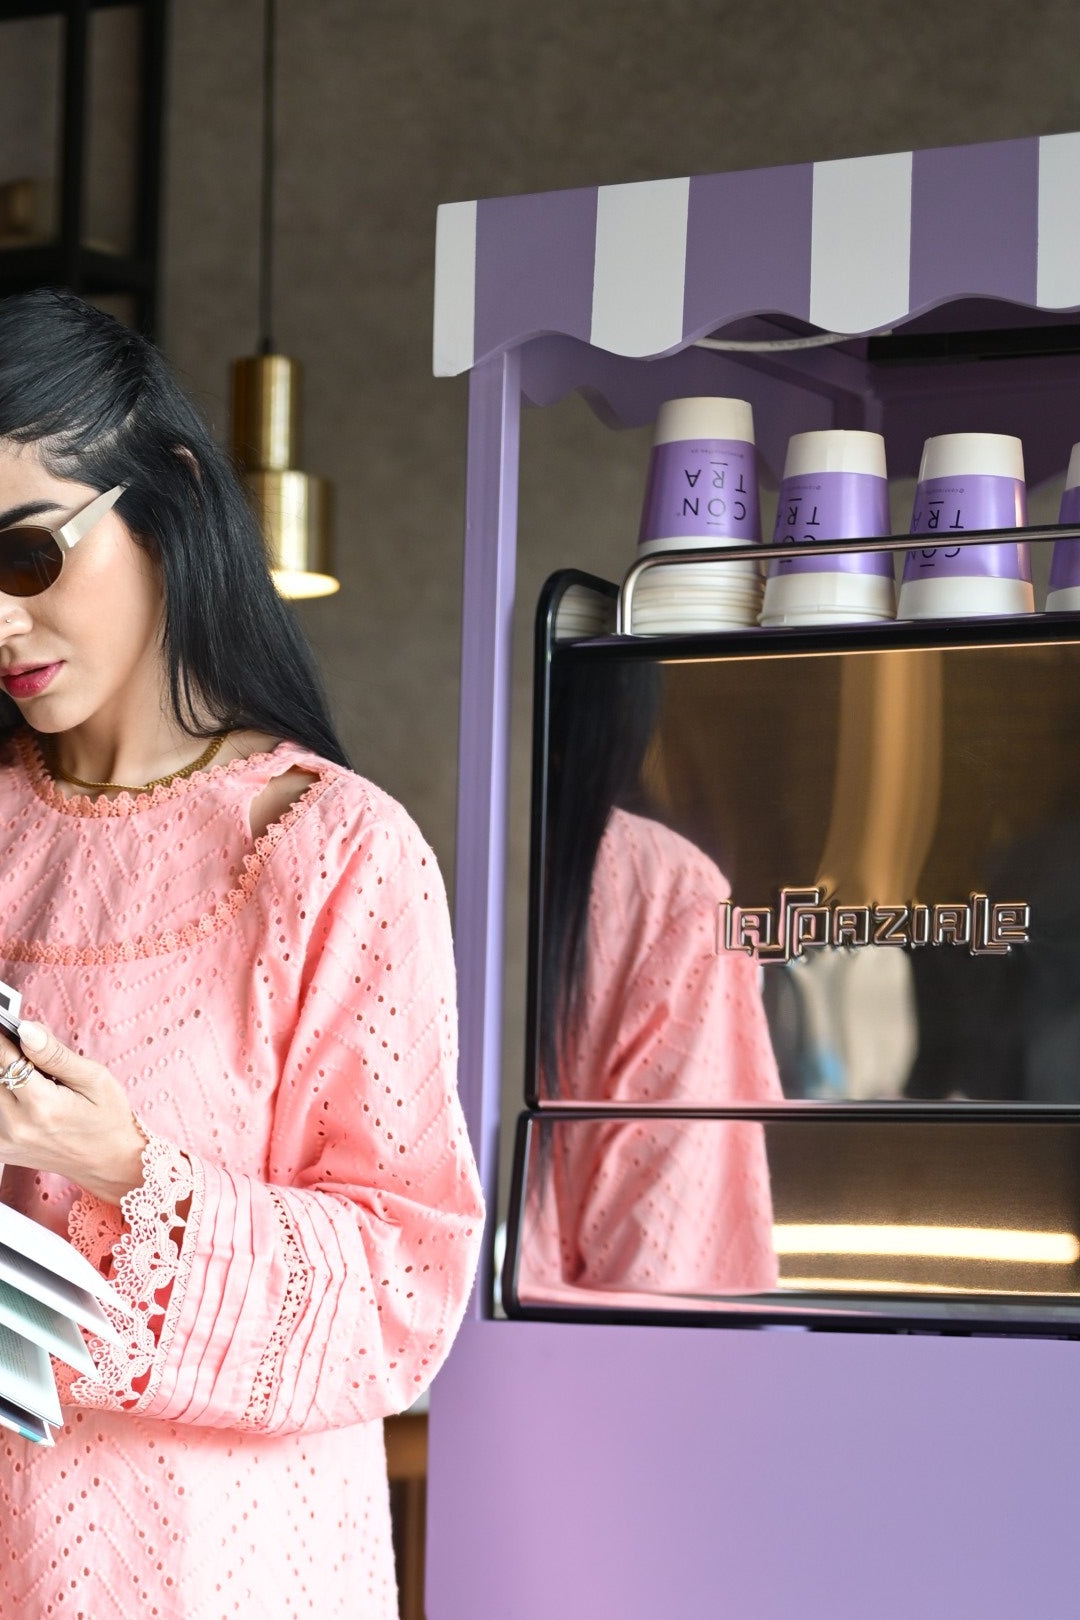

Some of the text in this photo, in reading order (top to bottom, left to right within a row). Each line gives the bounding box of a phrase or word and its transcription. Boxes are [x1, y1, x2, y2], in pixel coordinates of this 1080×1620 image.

[684, 469, 747, 494] TRA
[682, 498, 747, 521] CON
[777, 506, 820, 526] TR
